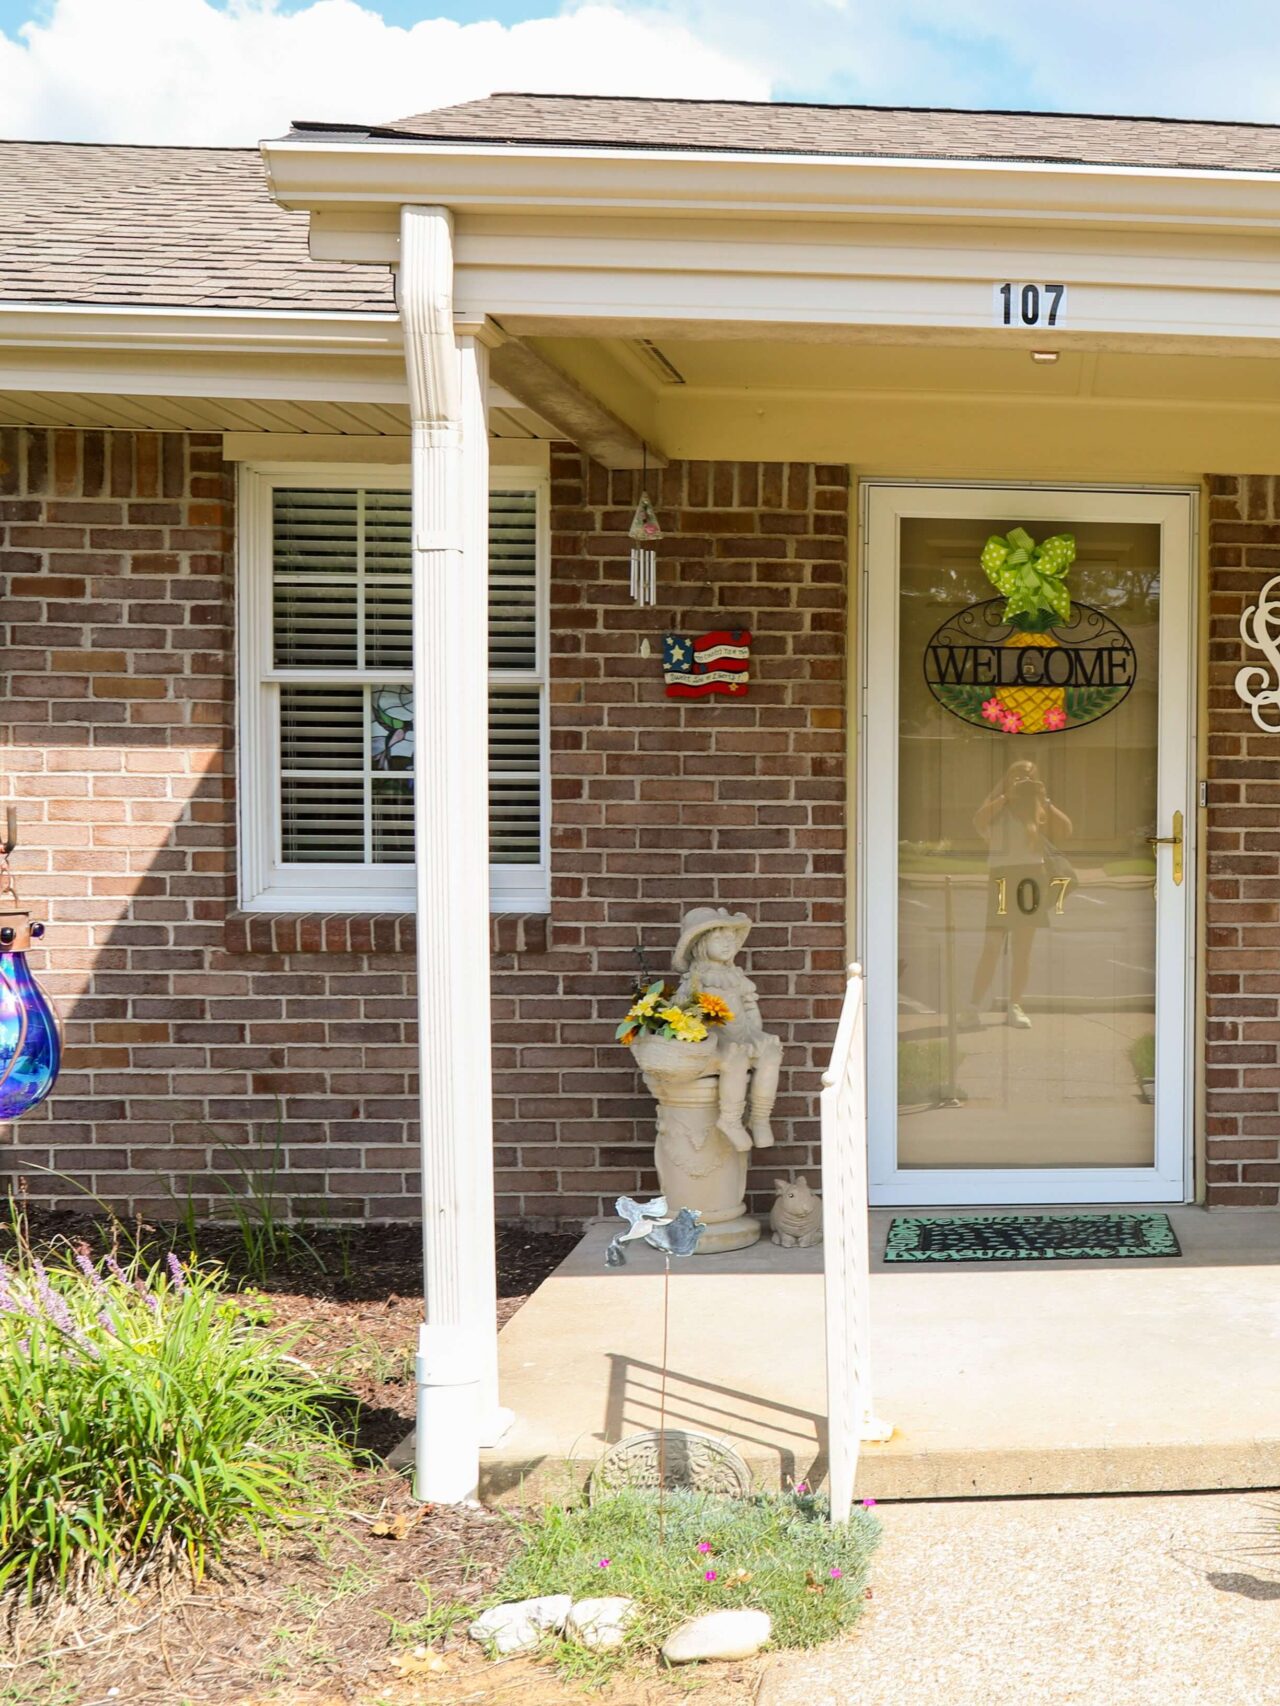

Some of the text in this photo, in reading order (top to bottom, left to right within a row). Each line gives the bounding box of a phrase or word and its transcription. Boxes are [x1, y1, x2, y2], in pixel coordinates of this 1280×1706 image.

[1000, 283, 1064, 326] 107
[928, 646, 1134, 687] WELCOME
[995, 877, 1072, 915] 107
